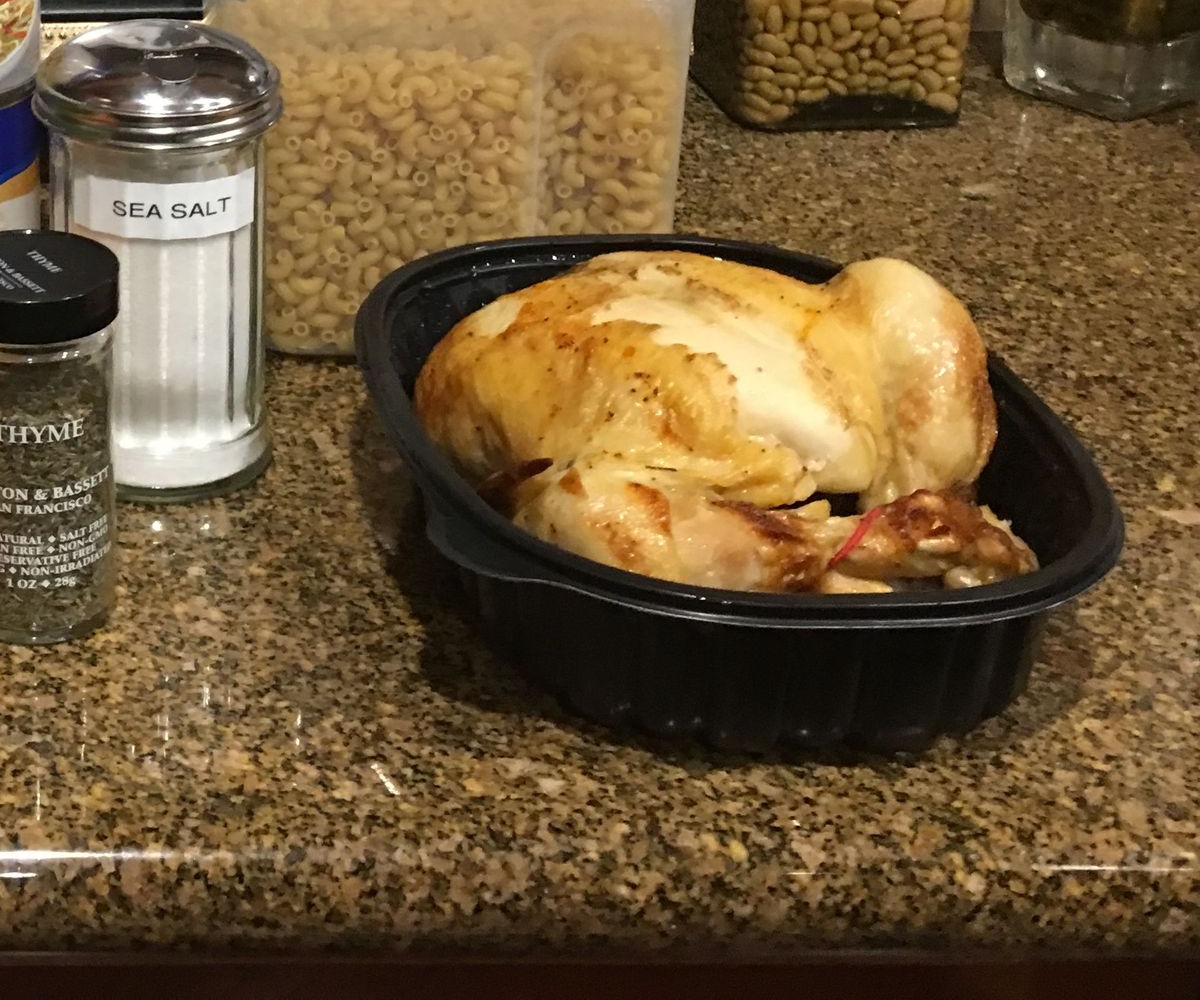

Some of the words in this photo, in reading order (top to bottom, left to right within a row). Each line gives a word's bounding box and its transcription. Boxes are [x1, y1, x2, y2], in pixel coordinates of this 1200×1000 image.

[112, 200, 163, 219] SEA
[171, 196, 232, 219] SALT
[26, 250, 64, 273] THYME
[33, 488, 50, 501] &
[53, 465, 110, 499] BASSETT
[15, 494, 93, 515] FRANCISCO
[59, 527, 87, 539] SALT
[88, 515, 108, 533] FREE
[12, 544, 44, 555] FREE
[58, 524, 109, 553] NON-GMO
[72, 543, 98, 559] FREE
[6, 578, 14, 588] 1
[17, 579, 38, 589] OZ
[54, 576, 77, 588] 28g
